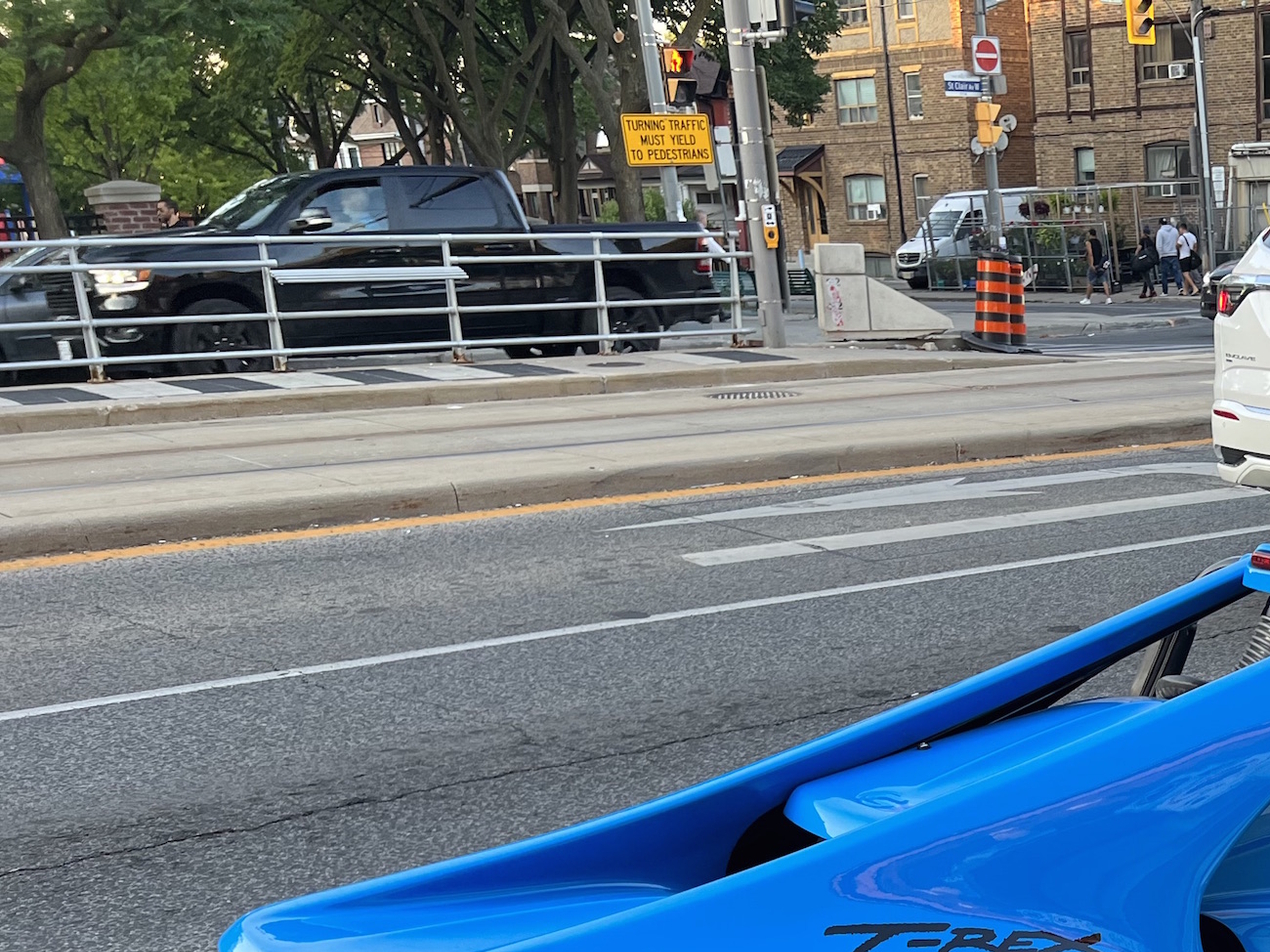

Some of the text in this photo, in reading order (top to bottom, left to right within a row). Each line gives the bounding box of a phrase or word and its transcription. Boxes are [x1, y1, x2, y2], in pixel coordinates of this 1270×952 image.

[947, 81, 954, 90] St
[955, 81, 968, 90] Clair
[626, 119, 706, 131] TURNING TRAFFIC
[640, 134, 697, 146] MUST YIELD
[630, 148, 710, 161] TO PEDESTRIANS
